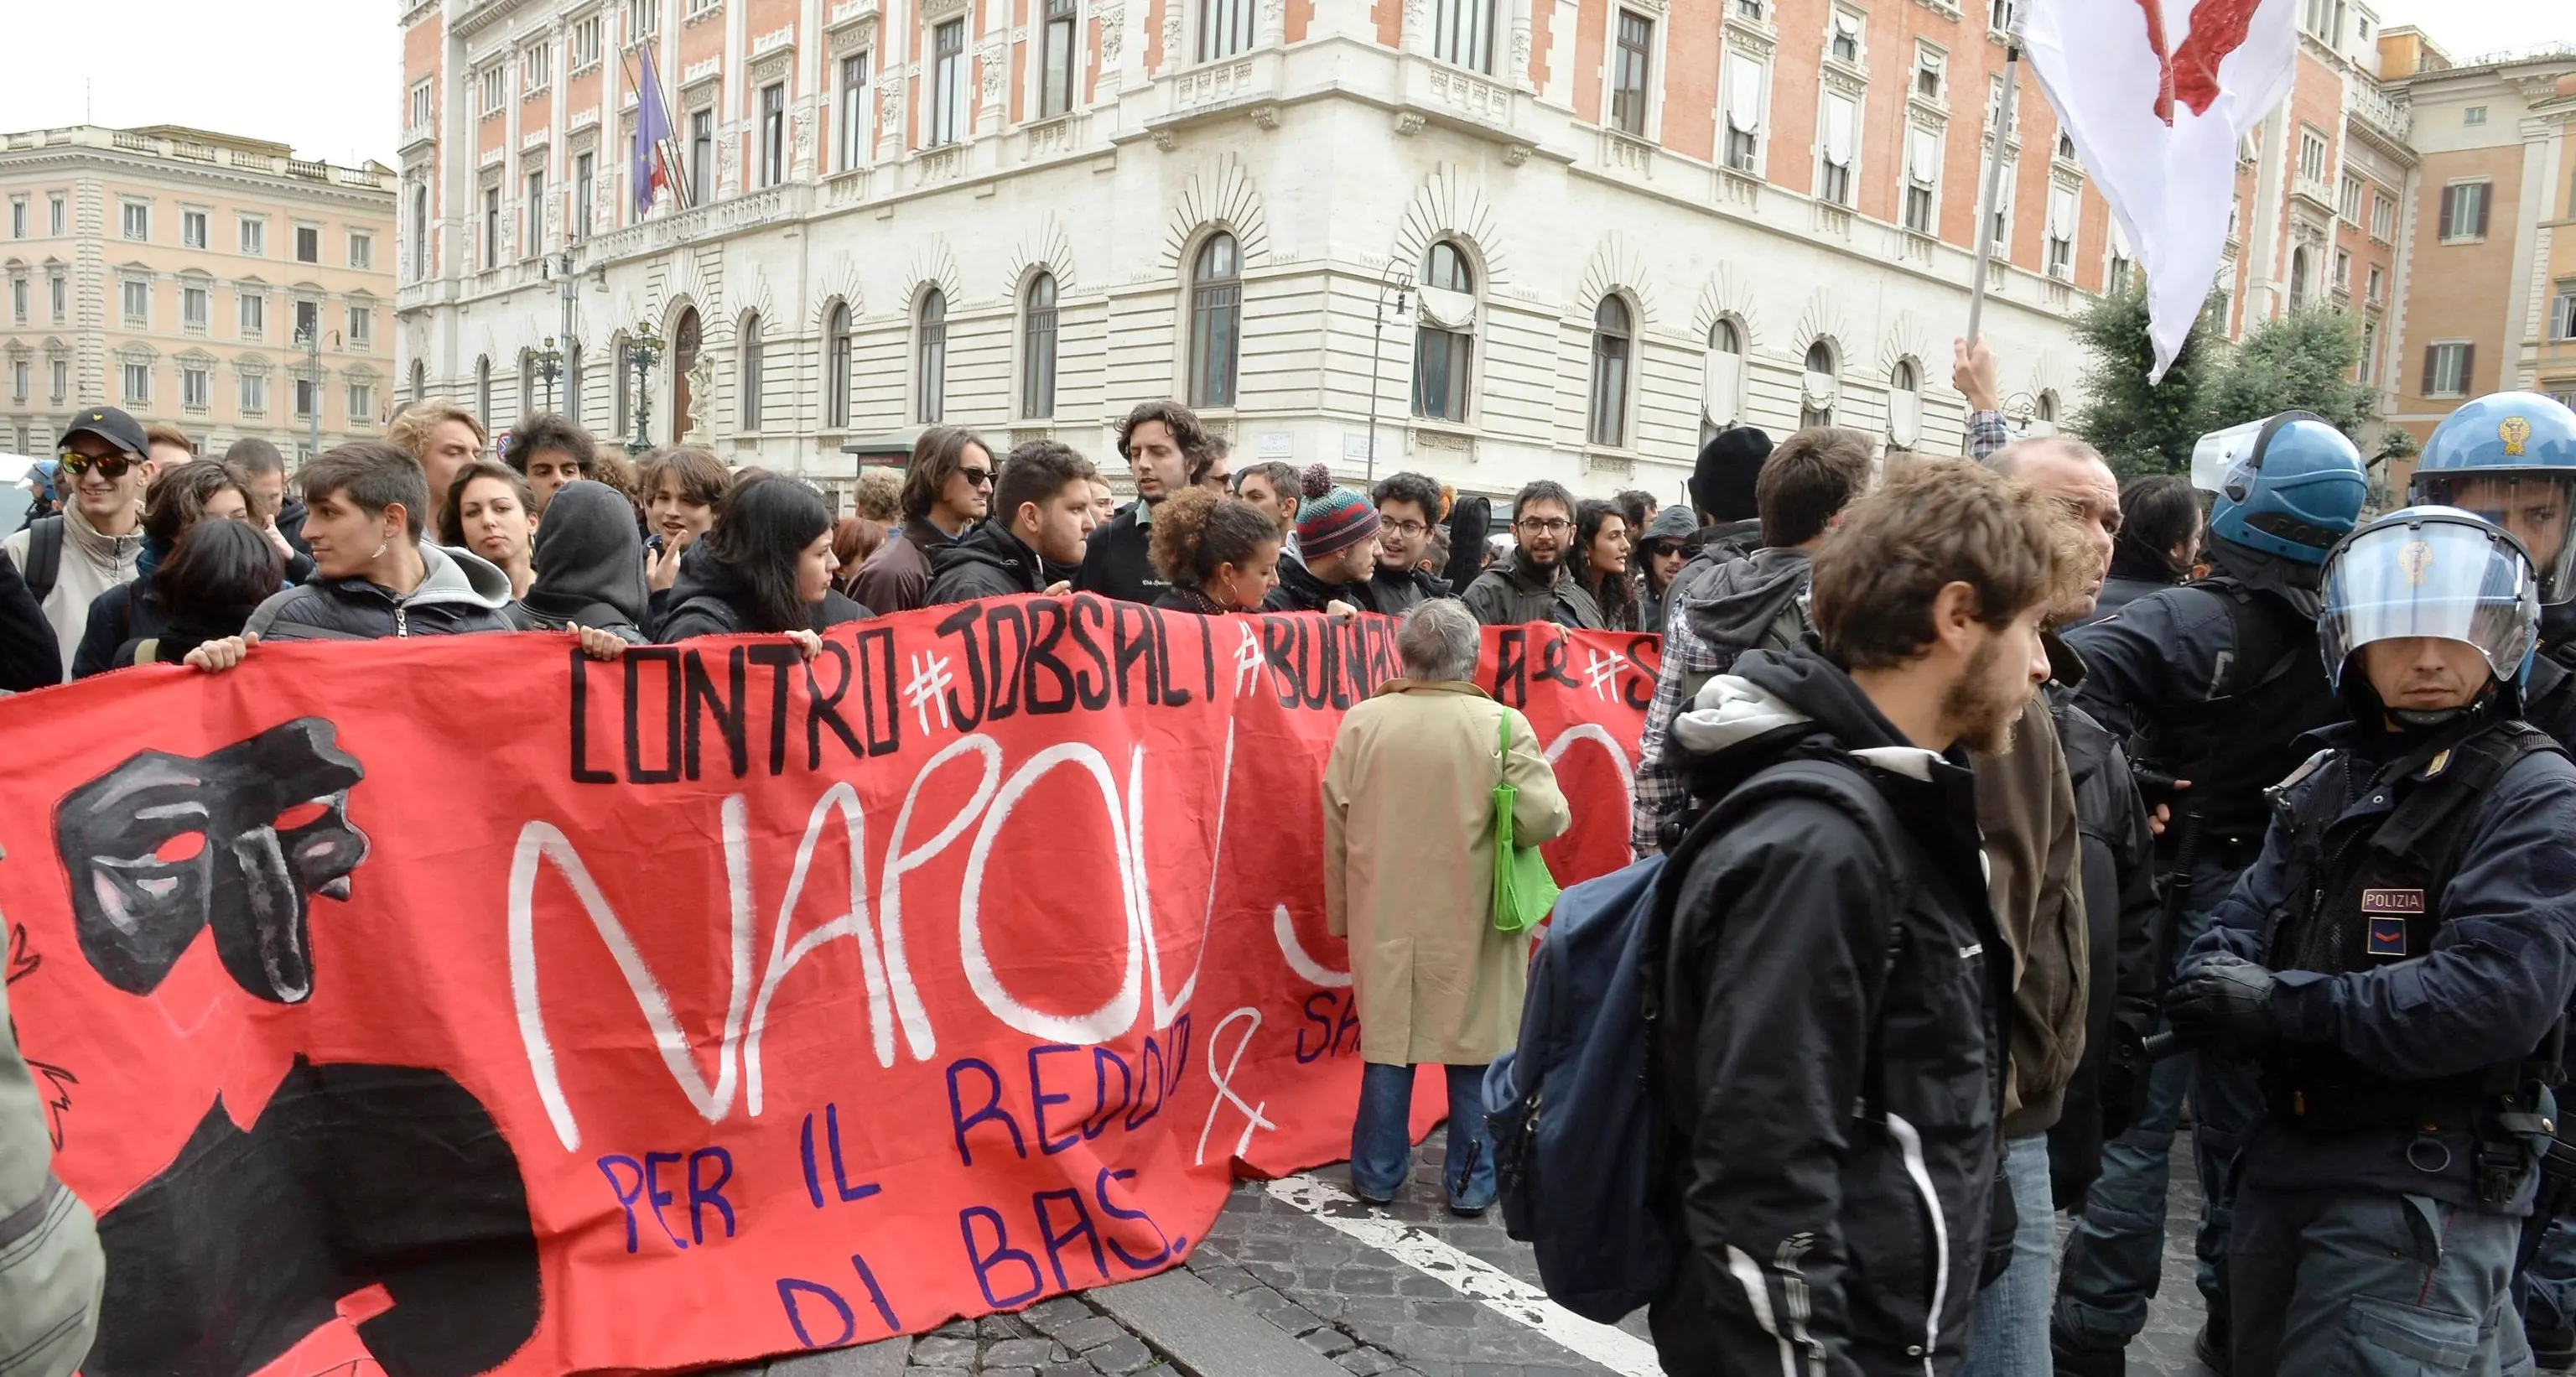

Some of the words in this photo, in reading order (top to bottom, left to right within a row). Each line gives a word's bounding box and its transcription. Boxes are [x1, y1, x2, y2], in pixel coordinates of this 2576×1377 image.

[570, 626, 900, 784] CONTRO
[2366, 893, 2421, 908] POLIZIA
[597, 1146, 736, 1253] PER
[800, 1102, 883, 1208] IL
[776, 1254, 901, 1349] DI
